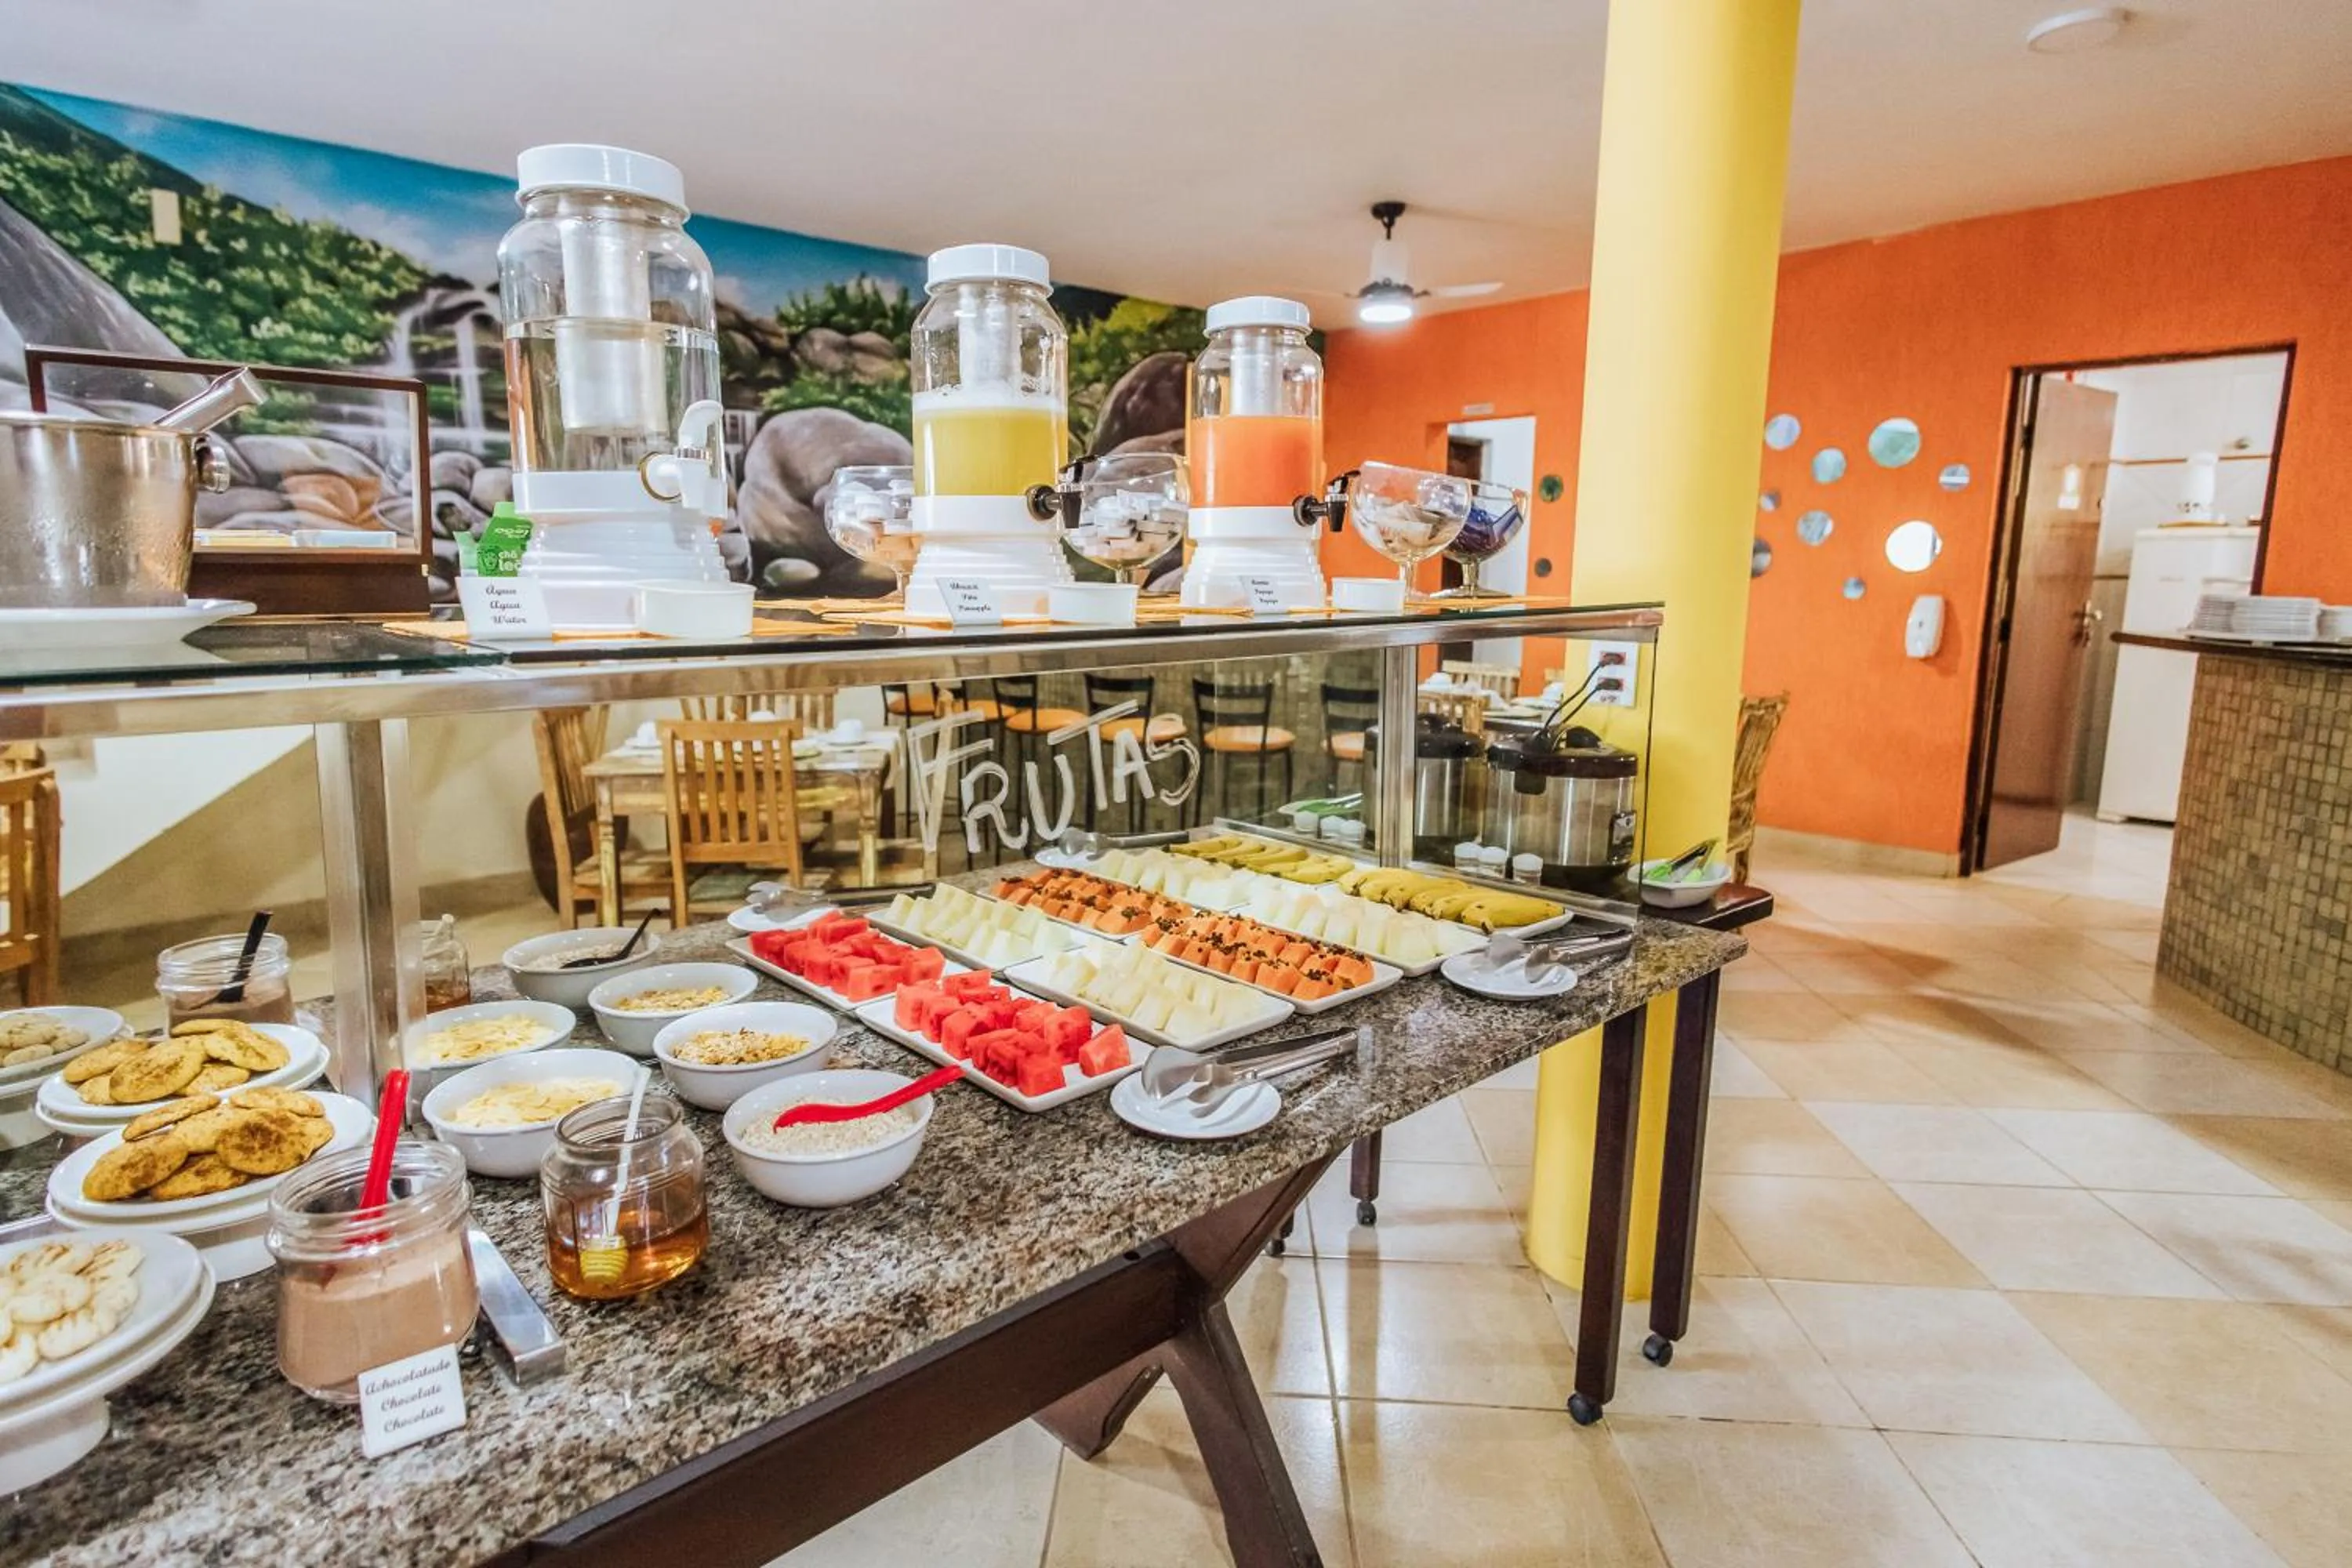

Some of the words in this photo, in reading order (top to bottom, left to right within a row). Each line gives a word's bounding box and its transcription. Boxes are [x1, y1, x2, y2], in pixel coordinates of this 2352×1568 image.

[907, 699, 1200, 854] FRUTAS
[365, 1359, 452, 1396] Achocolatado
[380, 1383, 442, 1412] Chocolate
[383, 1404, 445, 1433] Chocolate
